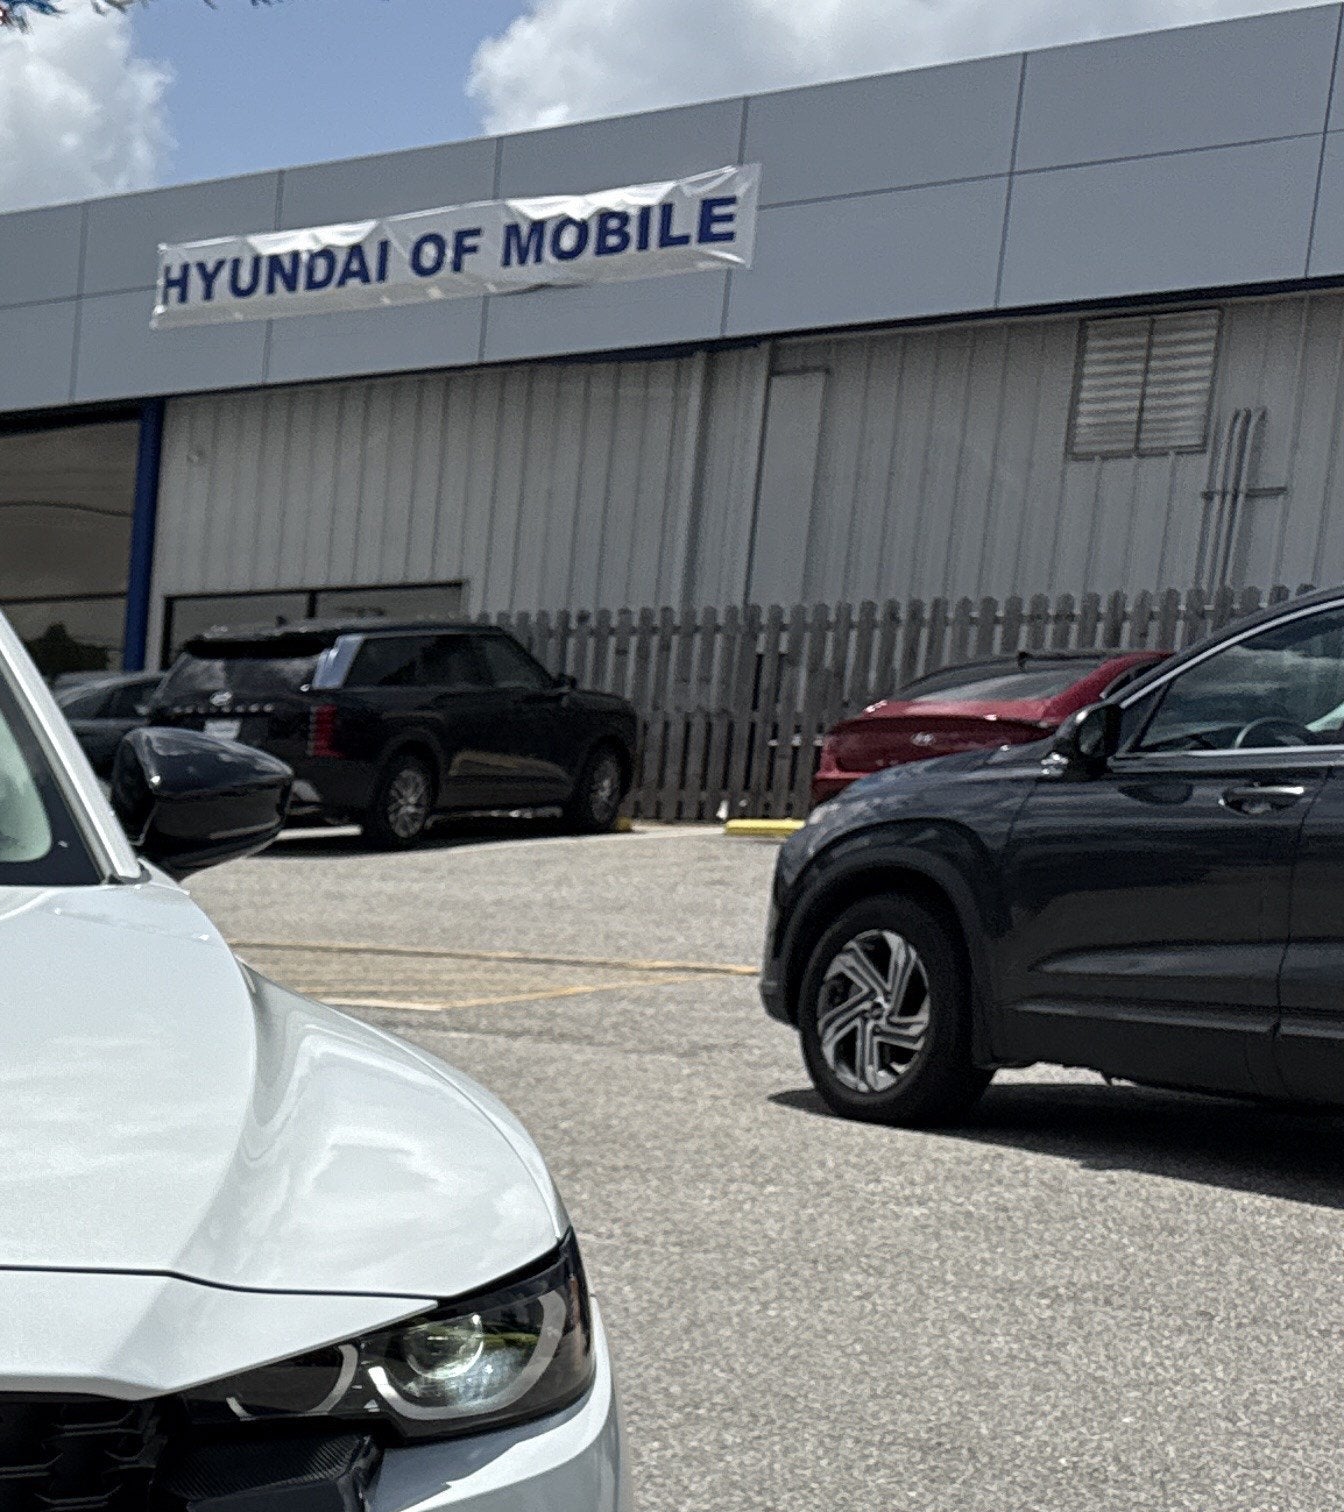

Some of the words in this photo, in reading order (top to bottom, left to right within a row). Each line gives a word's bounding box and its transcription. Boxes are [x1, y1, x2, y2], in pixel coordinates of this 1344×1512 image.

[163, 239, 390, 304] HYUNDAI
[409, 228, 483, 278] OF
[501, 195, 739, 268] MOBILE
